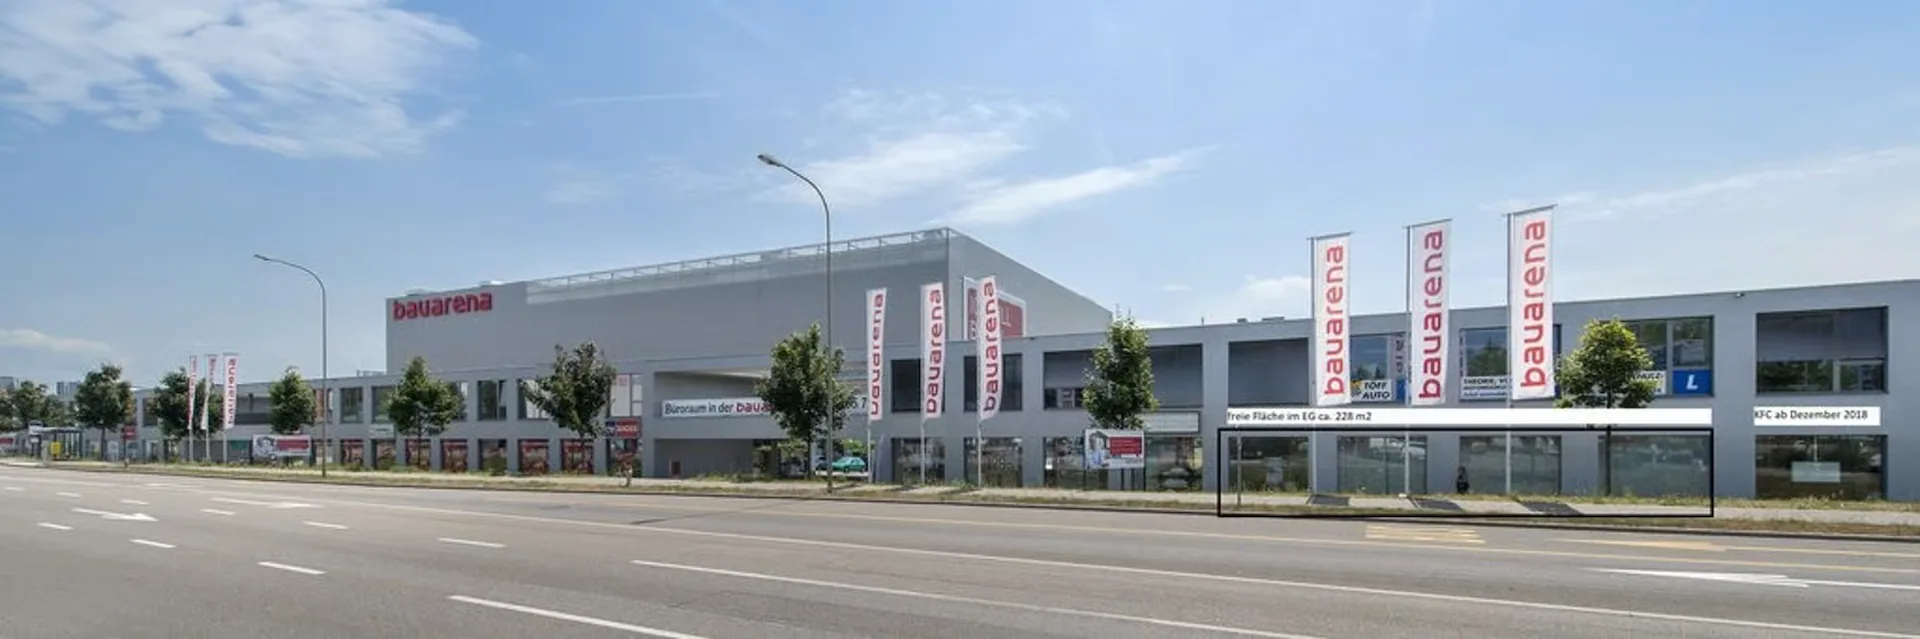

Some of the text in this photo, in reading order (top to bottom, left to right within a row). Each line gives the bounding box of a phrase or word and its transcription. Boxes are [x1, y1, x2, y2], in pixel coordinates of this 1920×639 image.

[393, 292, 492, 320] bauarena
[926, 289, 942, 413] bauarena
[984, 281, 999, 412] bauarena
[1324, 245, 1345, 395] bauarena
[1419, 230, 1443, 398] bauarena
[1520, 221, 1547, 388] bauarena
[665, 402, 708, 415] Büroraum
[708, 402, 717, 412] in
[718, 401, 734, 413] der
[1362, 391, 1390, 400] AUTO
[1686, 374, 1698, 390] L
